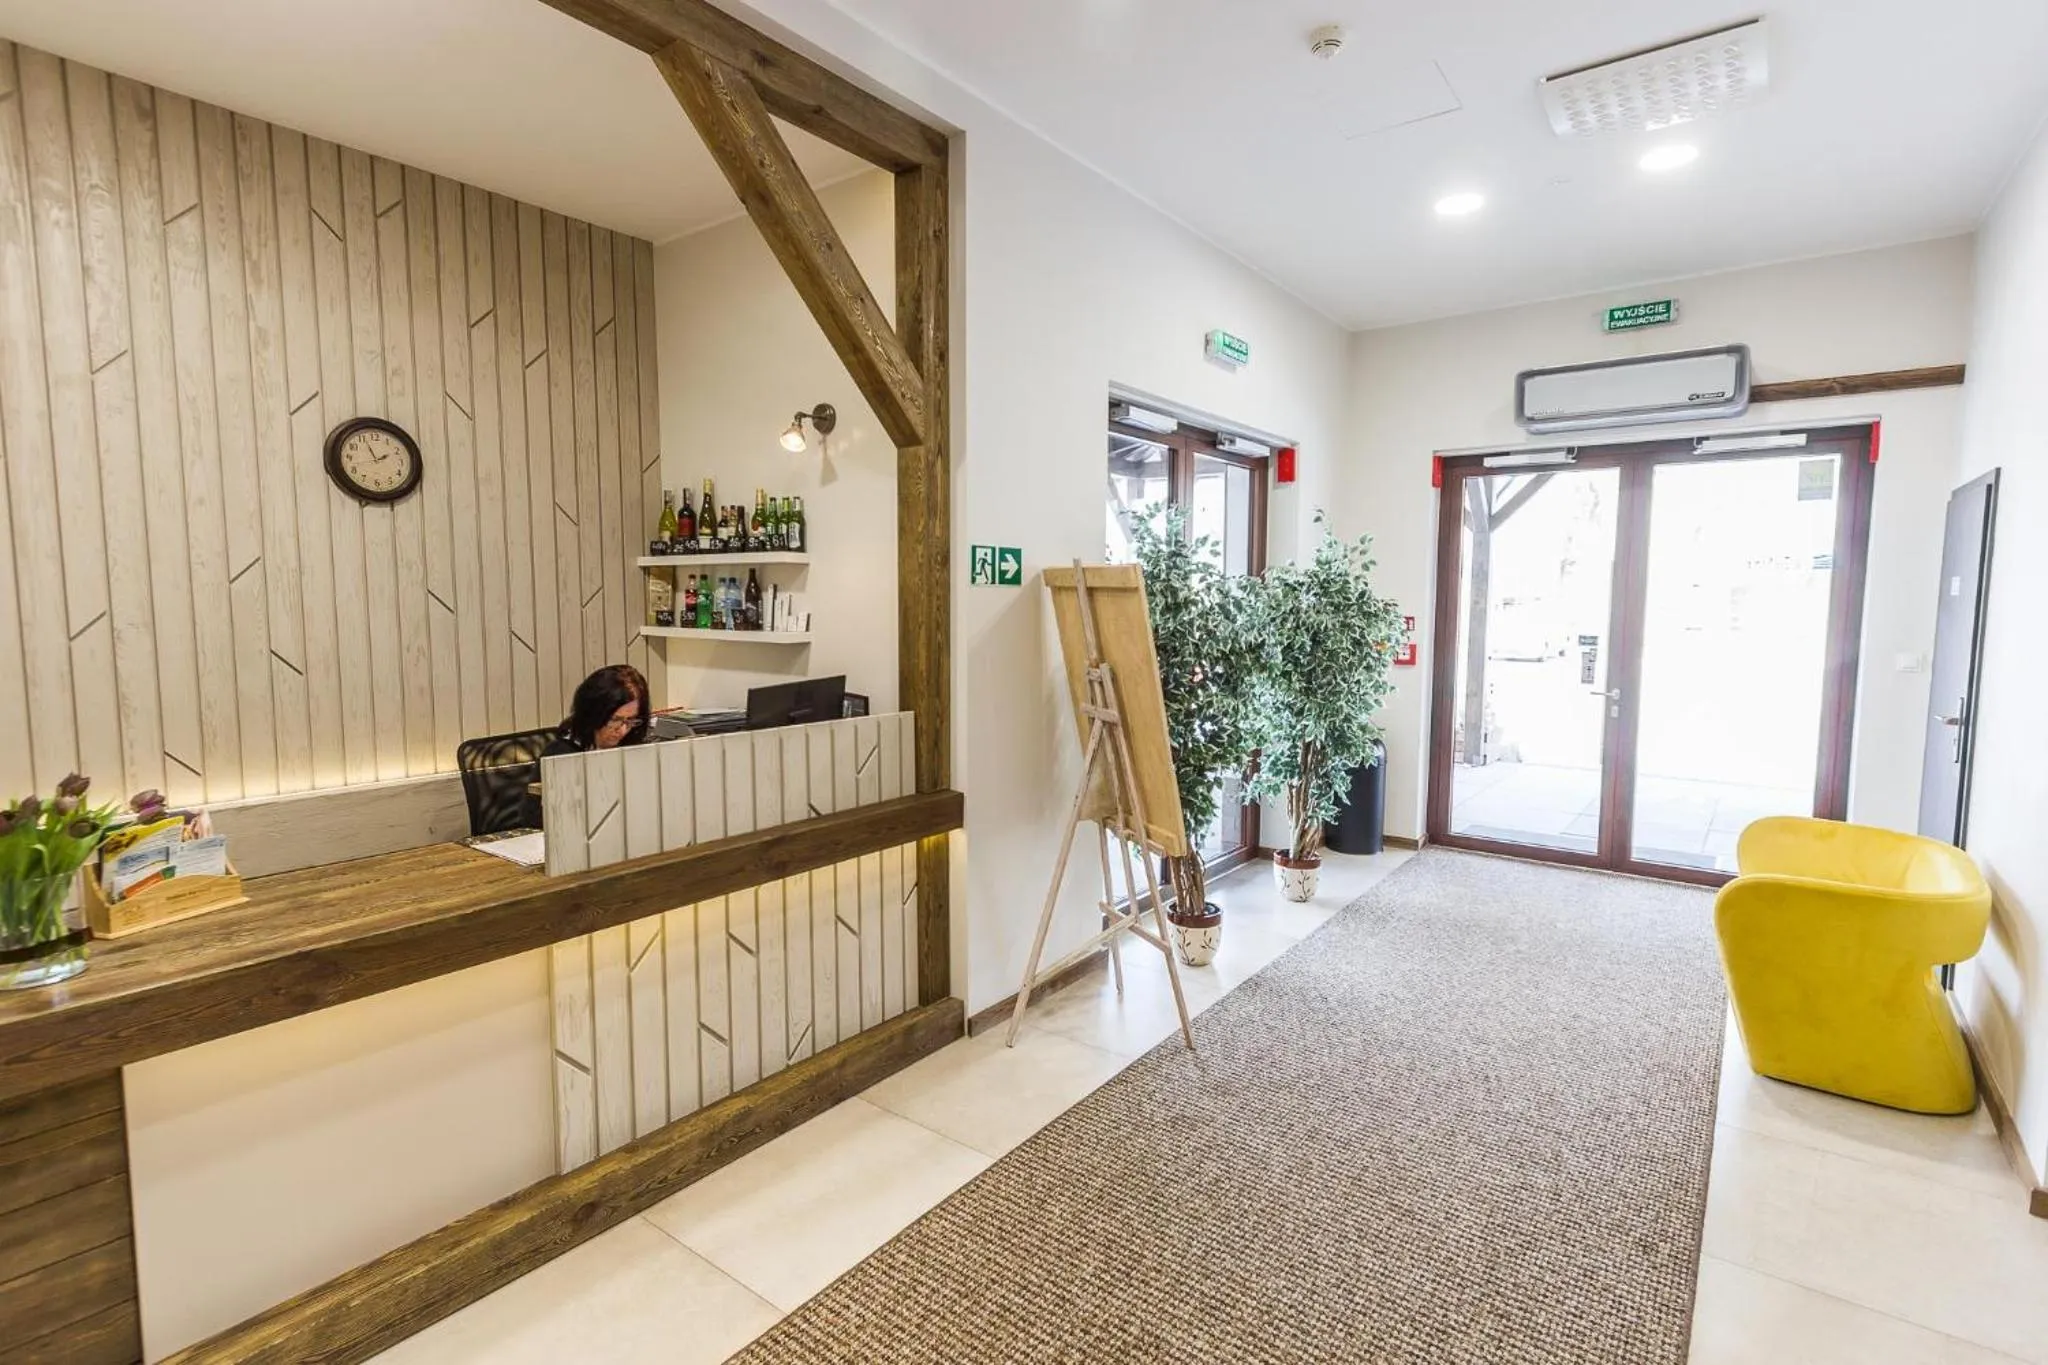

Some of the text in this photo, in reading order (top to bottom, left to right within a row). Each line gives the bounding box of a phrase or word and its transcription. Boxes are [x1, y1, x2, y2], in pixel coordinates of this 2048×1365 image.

[1613, 303, 1667, 319] WYJŚCIE
[358, 435, 366, 443] 11
[370, 433, 380, 441] 12
[394, 446, 400, 455] 2
